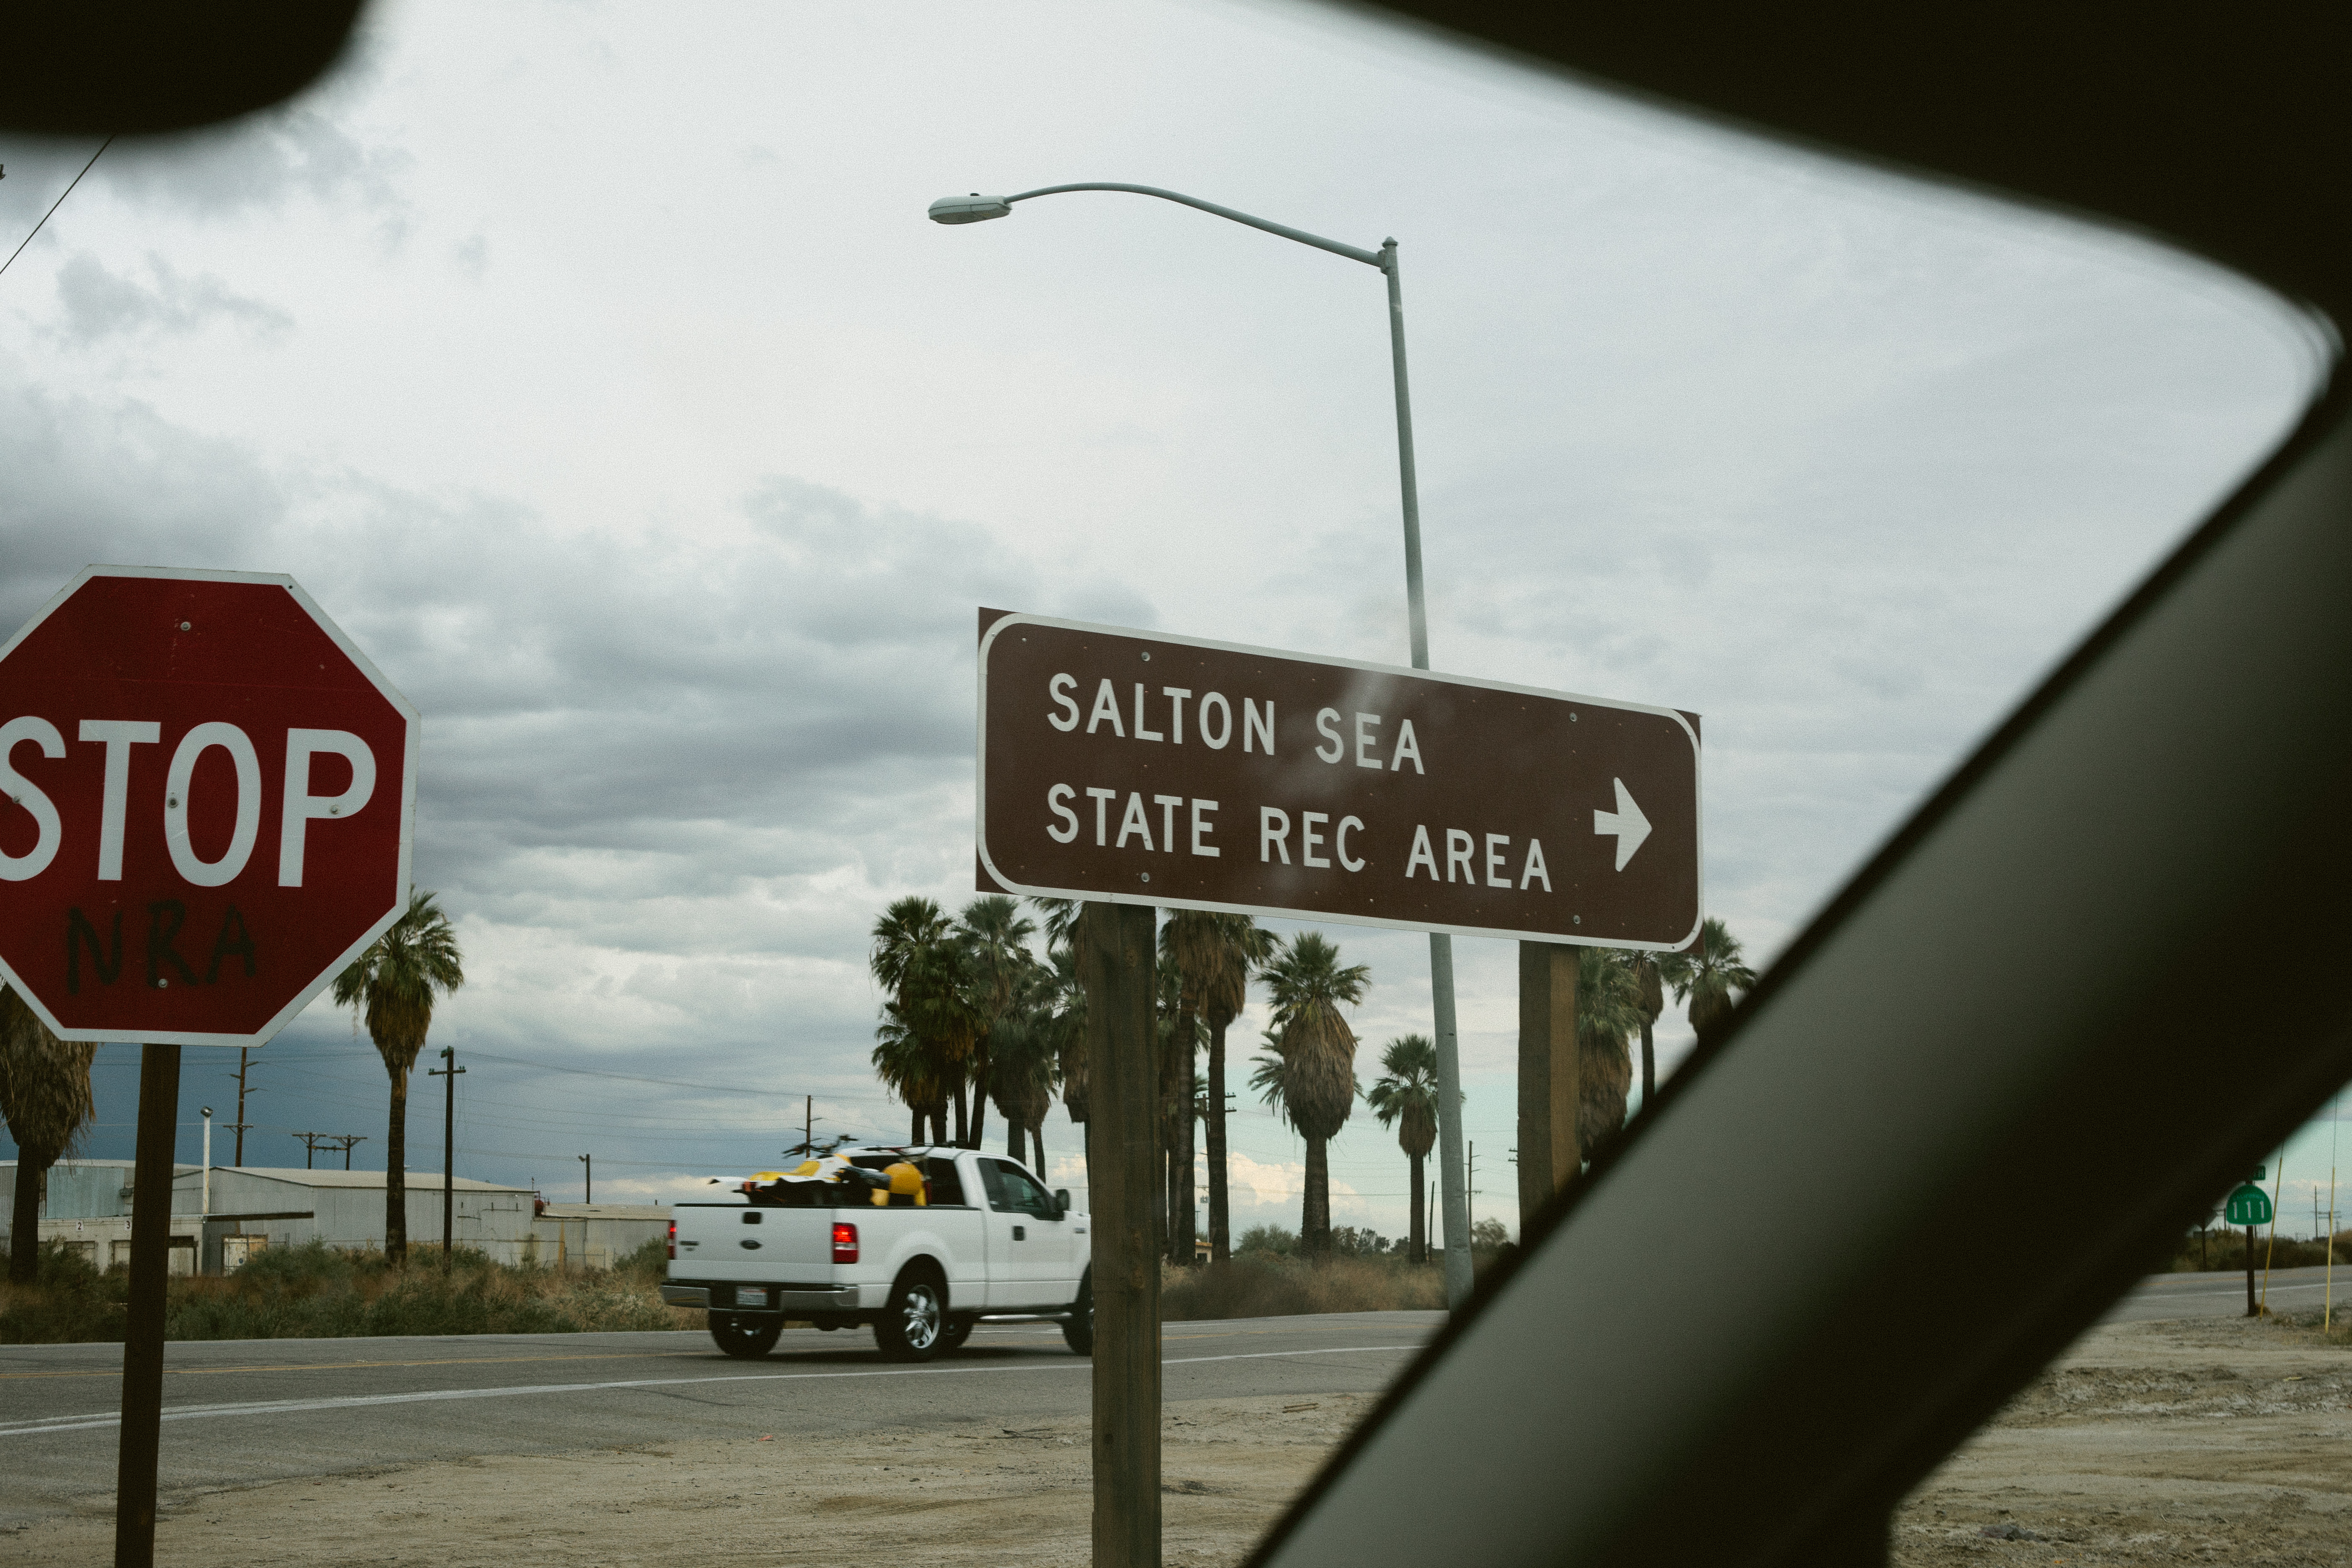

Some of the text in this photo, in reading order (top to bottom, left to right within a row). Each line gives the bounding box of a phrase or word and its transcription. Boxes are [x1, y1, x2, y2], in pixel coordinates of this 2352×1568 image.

[1047, 673, 1424, 774] SALTON SEA
[0, 716, 377, 887] STOP
[1046, 783, 1552, 892] STATE REC AREA
[67, 899, 256, 996] NRA
[77, 1222, 82, 1230] 2
[126, 1220, 130, 1229] 3
[2233, 1201, 2264, 1219] 111
